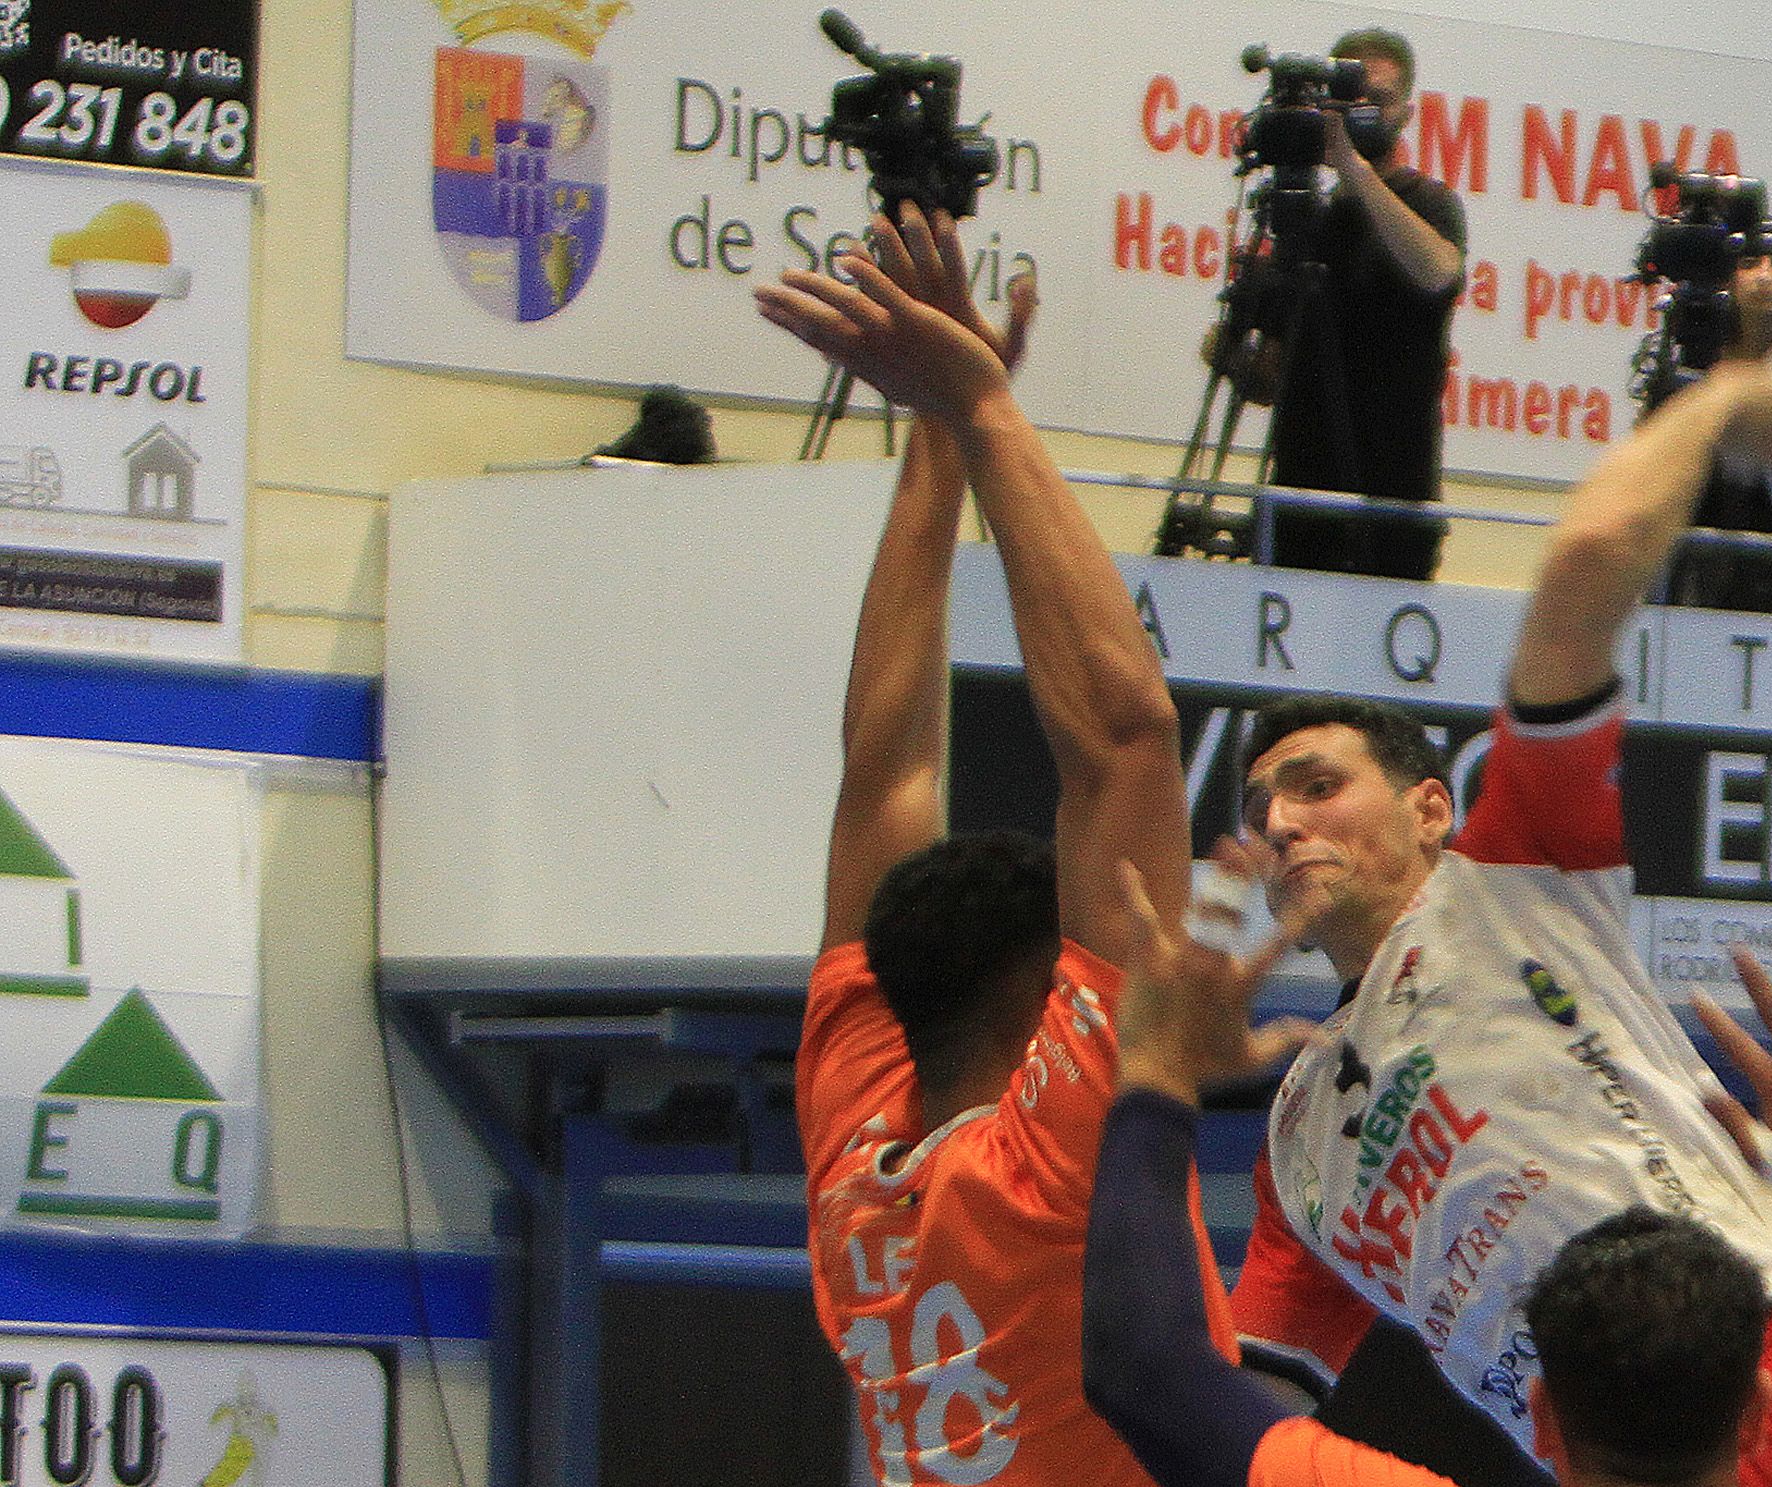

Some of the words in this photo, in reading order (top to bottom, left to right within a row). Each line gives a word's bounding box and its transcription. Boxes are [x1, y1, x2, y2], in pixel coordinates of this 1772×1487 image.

[63, 33, 163, 75] Pedidos
[170, 49, 187, 79] y
[195, 46, 243, 80] Cita
[21, 79, 121, 148] 231
[134, 93, 251, 165] 848
[670, 194, 755, 275] de
[25, 350, 207, 404] REPSOL
